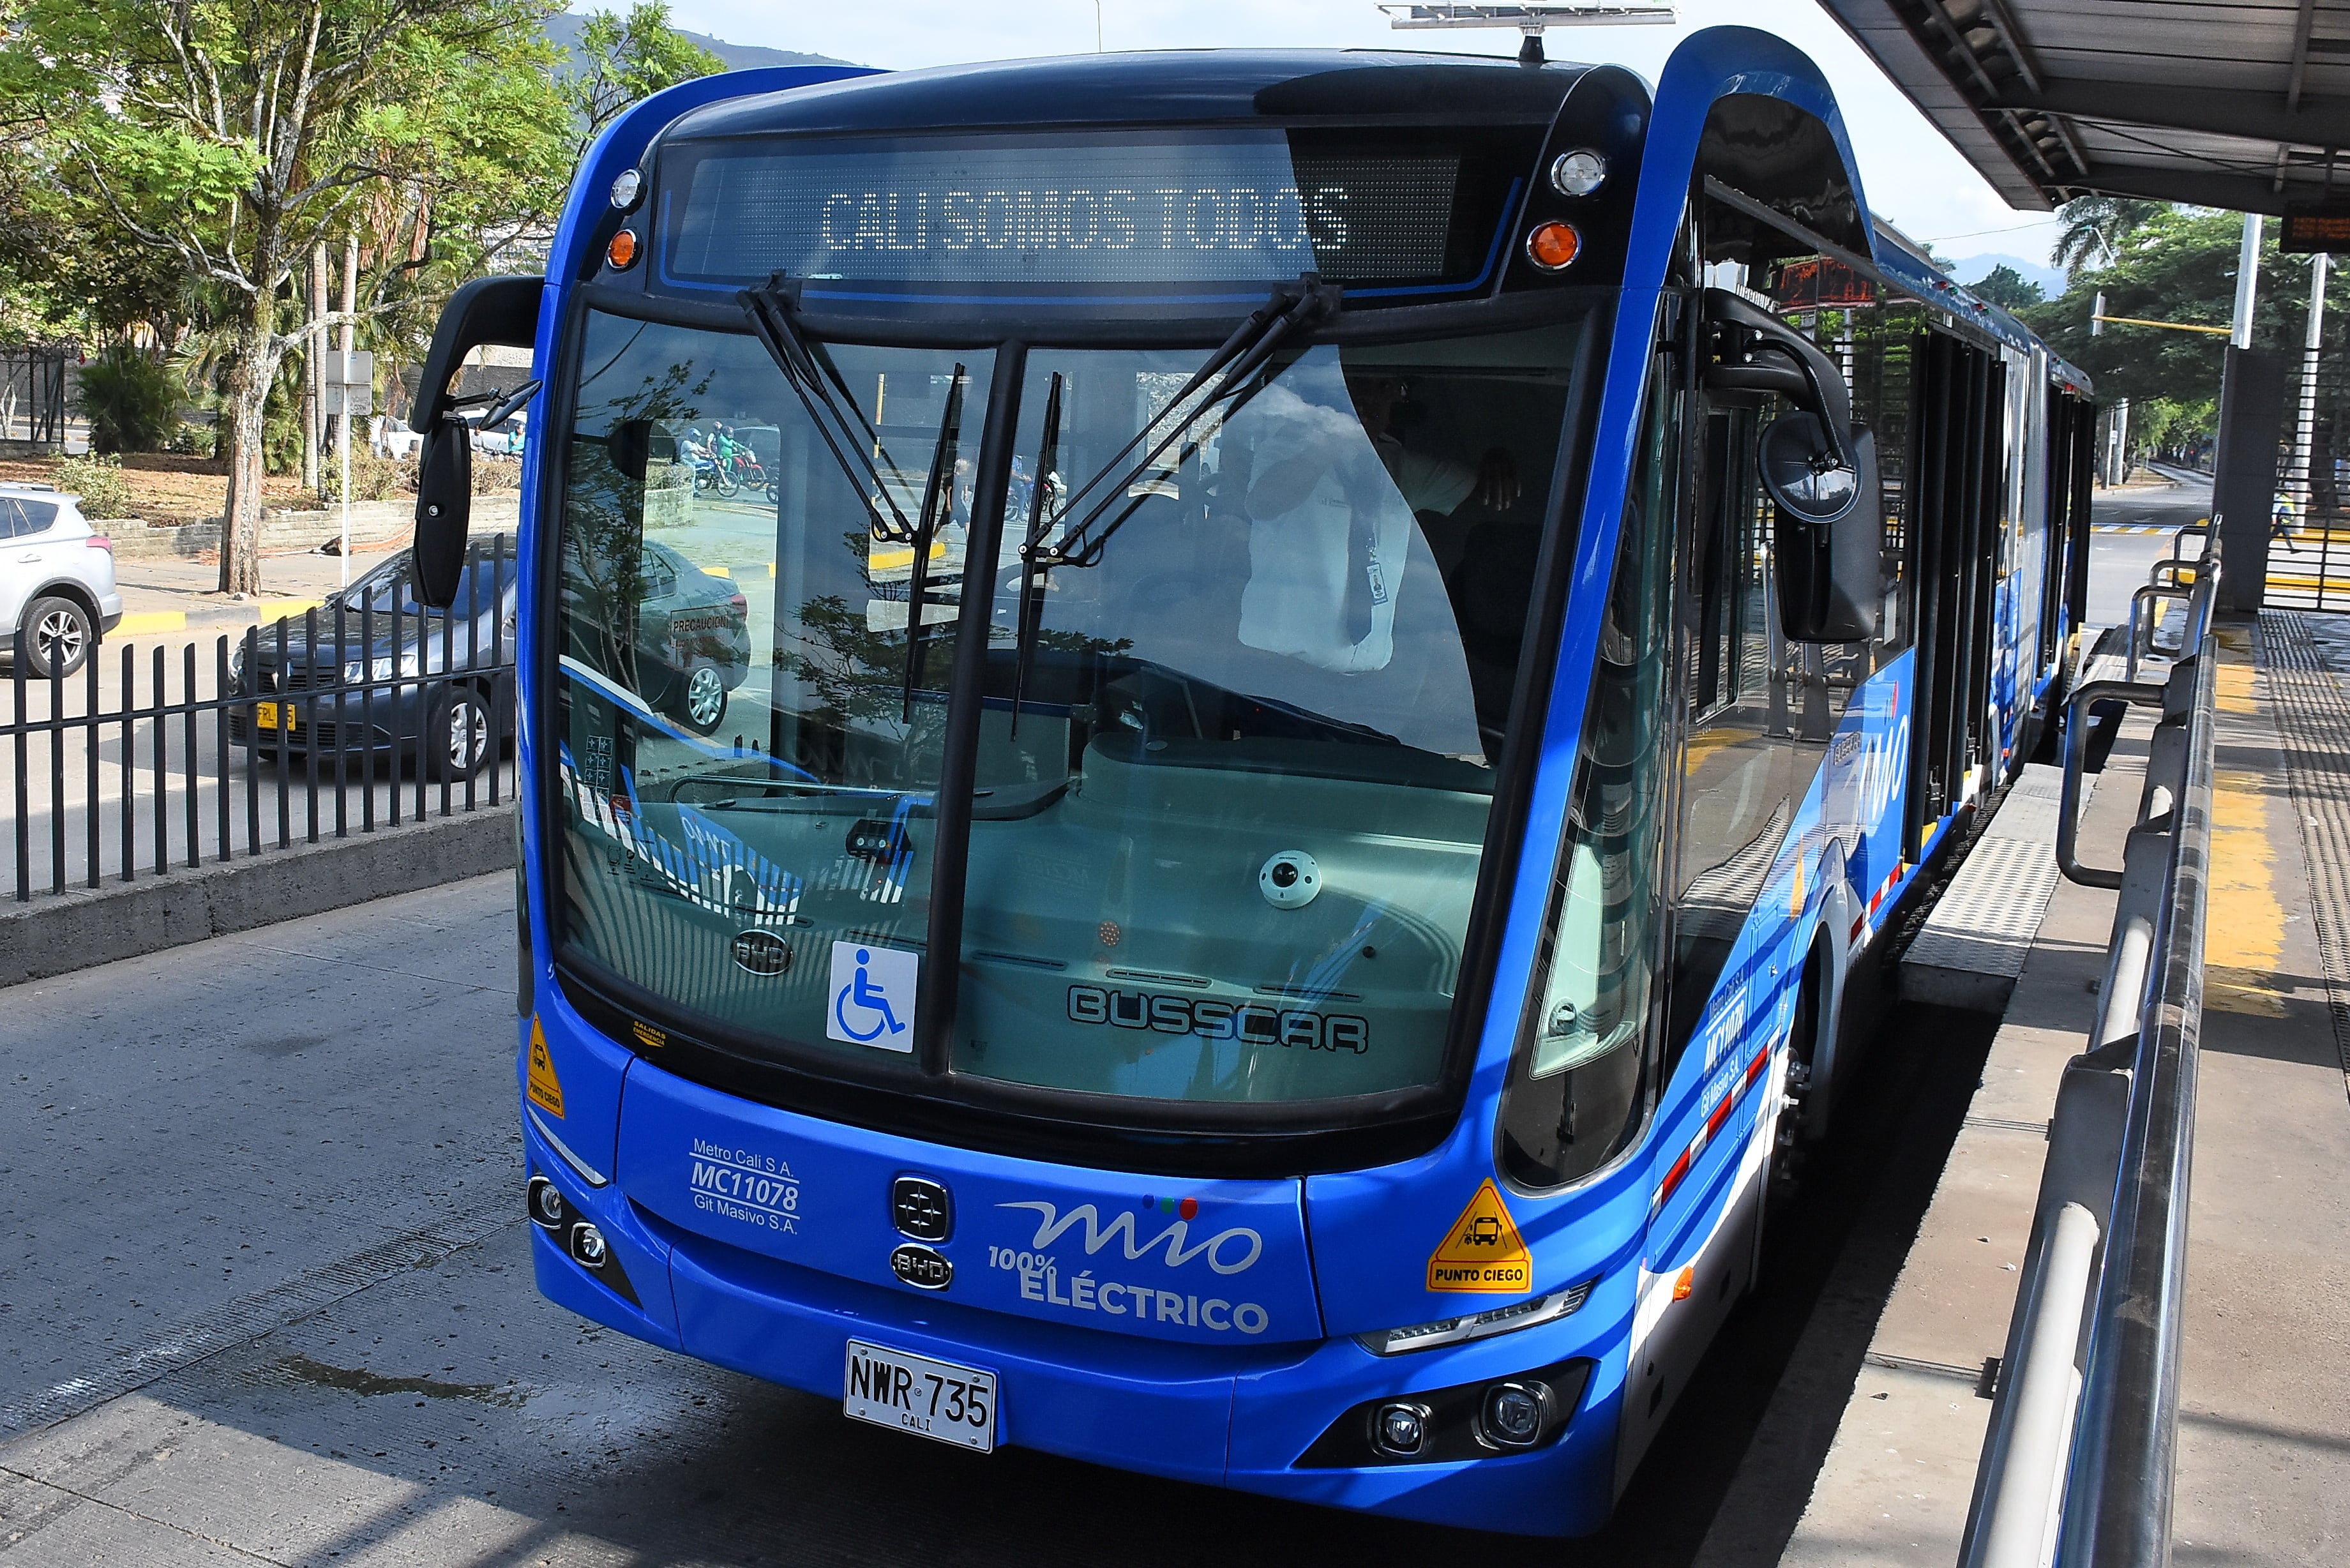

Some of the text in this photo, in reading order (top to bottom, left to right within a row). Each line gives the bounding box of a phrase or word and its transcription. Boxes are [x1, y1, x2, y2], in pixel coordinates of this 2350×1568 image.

[822, 187, 1350, 250] CALI SOMOS TODOS
[736, 942, 785, 964] BYD
[633, 1020, 666, 1040] SALIDAS
[1067, 984, 1369, 1055] BUSSCAR
[1703, 999, 1745, 1082] MC11078
[529, 1080, 561, 1108] PUNTO CIEGO
[693, 1138, 732, 1161] Metro
[735, 1149, 762, 1169] Cali
[691, 1161, 799, 1212] MC11078
[693, 1194, 798, 1235] Git Masivo S.A.
[897, 1253, 945, 1280] BYD
[988, 1245, 1057, 1277] 100%
[1435, 1268, 1523, 1281] PUNTO CIEGO
[1020, 1269, 1269, 1335] ELÉCTRICO
[850, 1354, 989, 1428] NWR 735
[901, 1412, 933, 1432] CALI
